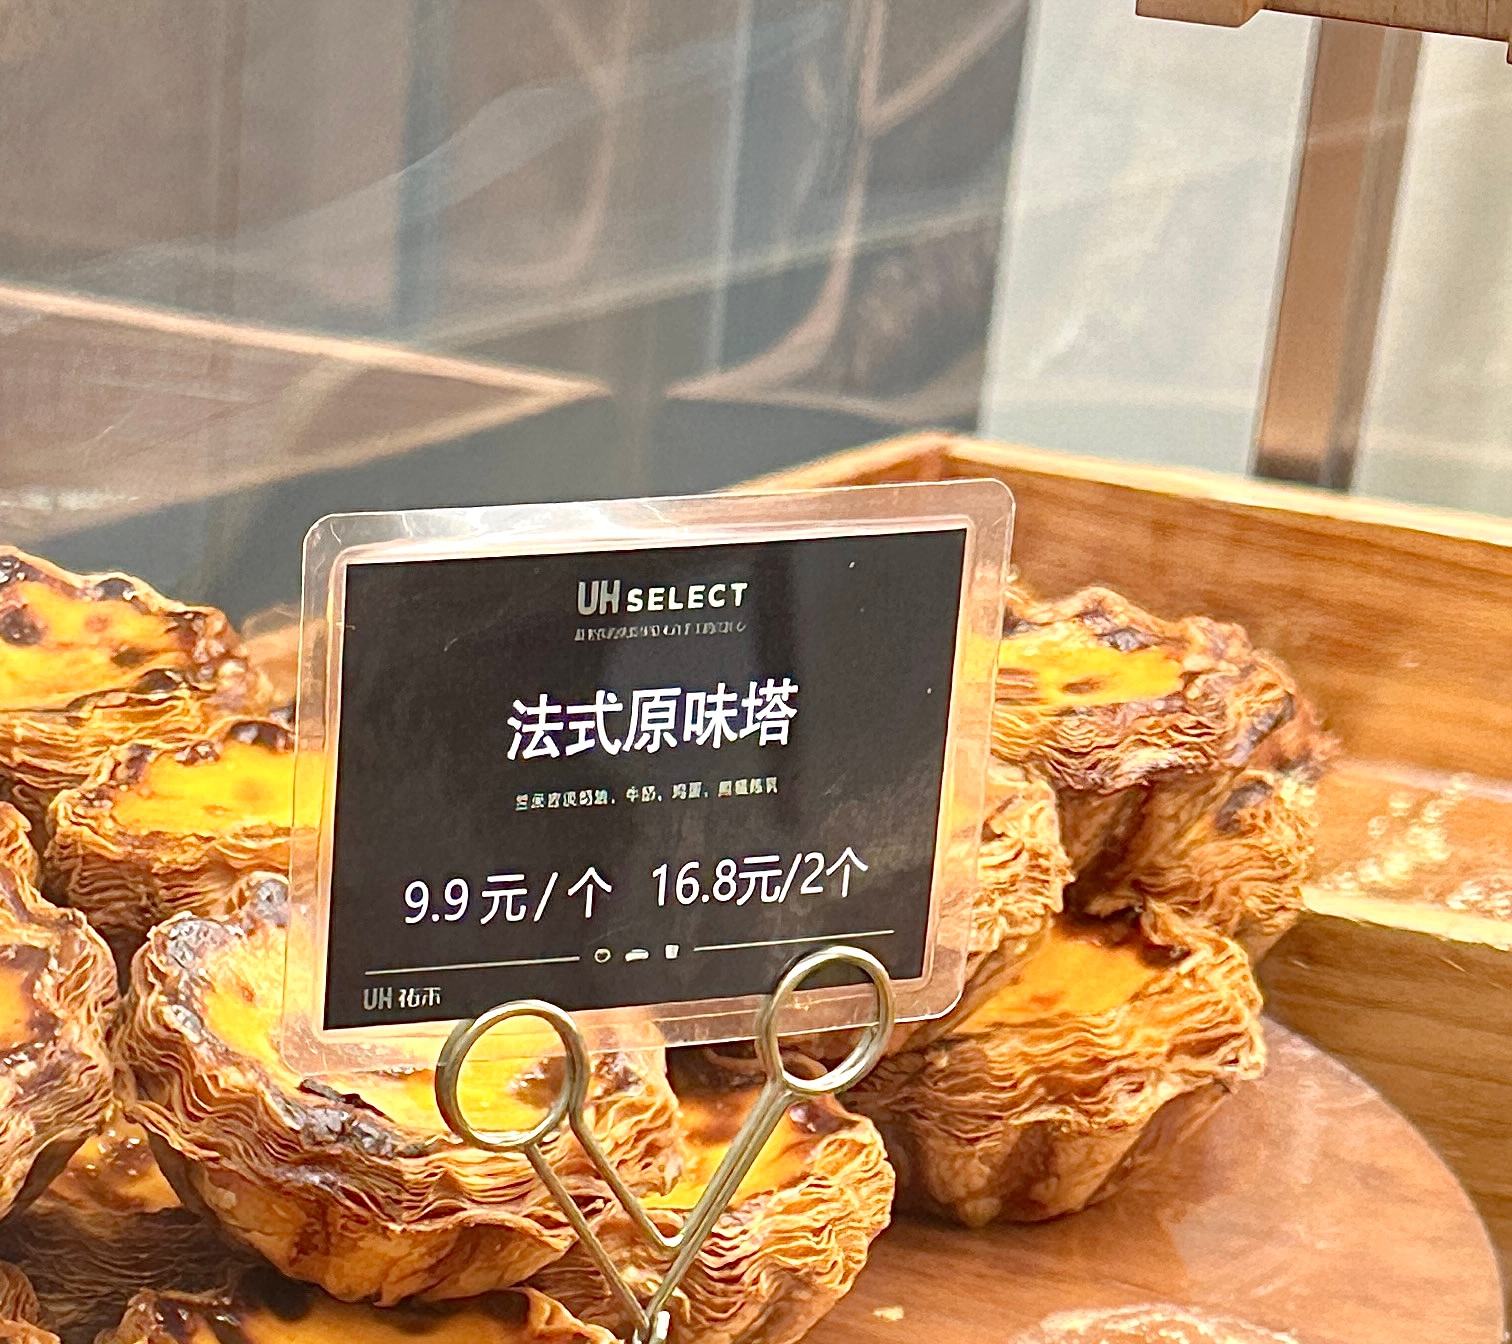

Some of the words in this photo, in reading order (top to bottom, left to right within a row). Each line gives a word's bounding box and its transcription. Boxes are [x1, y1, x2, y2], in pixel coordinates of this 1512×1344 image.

[577, 579, 621, 616] UH
[626, 582, 748, 613] SELECT
[506, 677, 799, 761] 法式原味塔
[652, 846, 869, 906] 16.8元/2个
[363, 986, 393, 1010] UH
